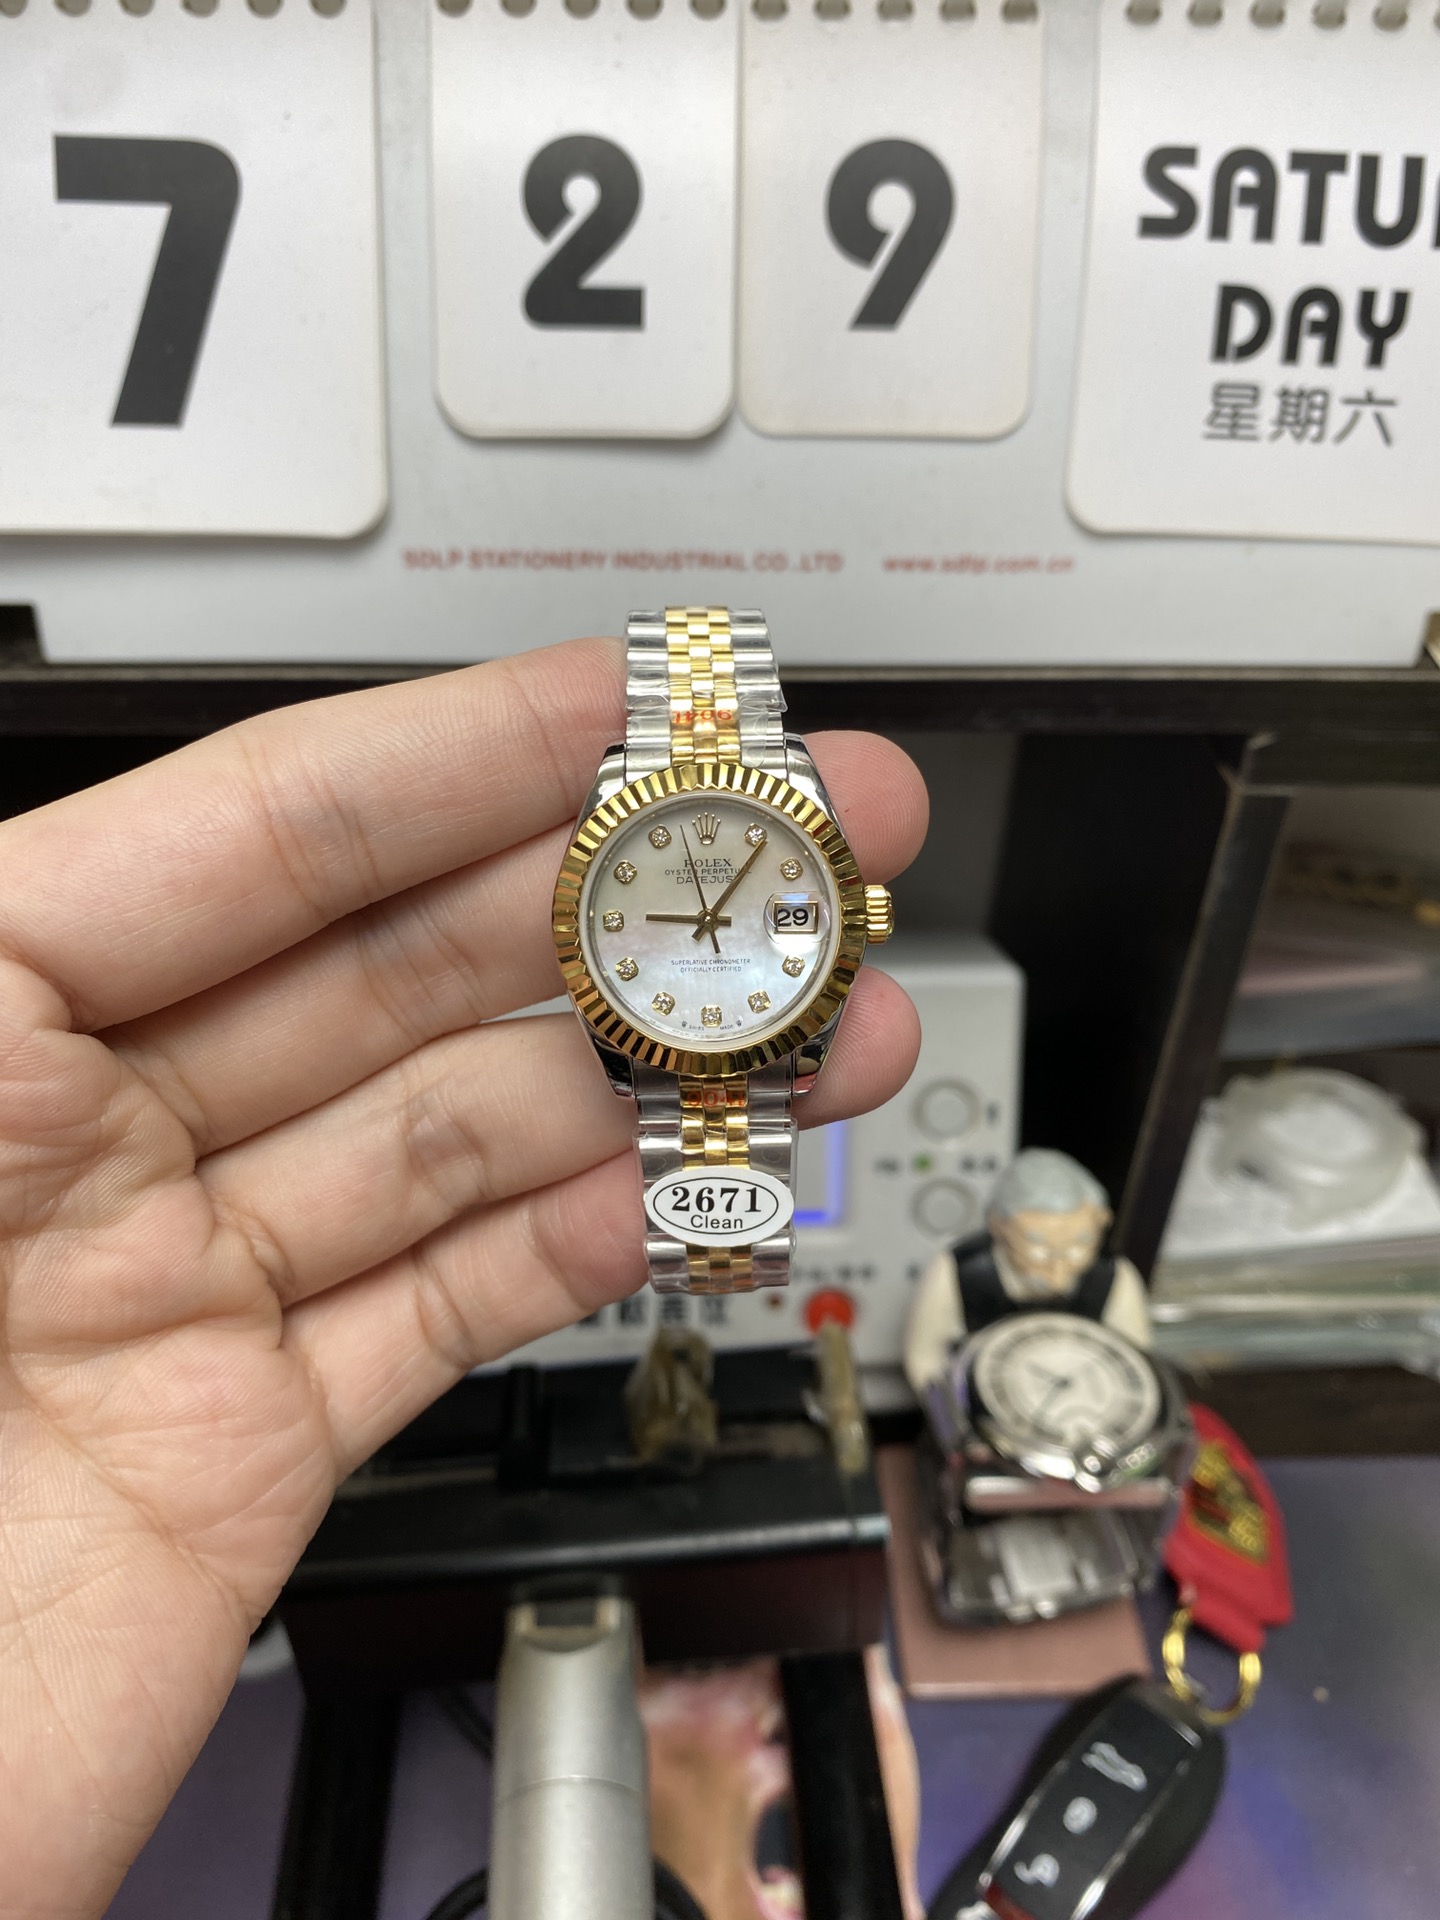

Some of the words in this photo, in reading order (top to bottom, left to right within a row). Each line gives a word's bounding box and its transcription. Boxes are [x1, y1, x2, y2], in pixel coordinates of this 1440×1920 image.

[1140, 147, 1440, 249] SATU
[55, 136, 239, 426] 7
[1212, 284, 1410, 368] DAY
[1205, 382, 1397, 446] 星期六
[468, 549, 606, 571] STATIONERY
[612, 551, 746, 571] INDUSTRIAL
[684, 858, 732, 868] ROLEX
[778, 908, 809, 926] 29
[671, 1186, 762, 1213] 2671
[690, 1214, 744, 1229] Clean
